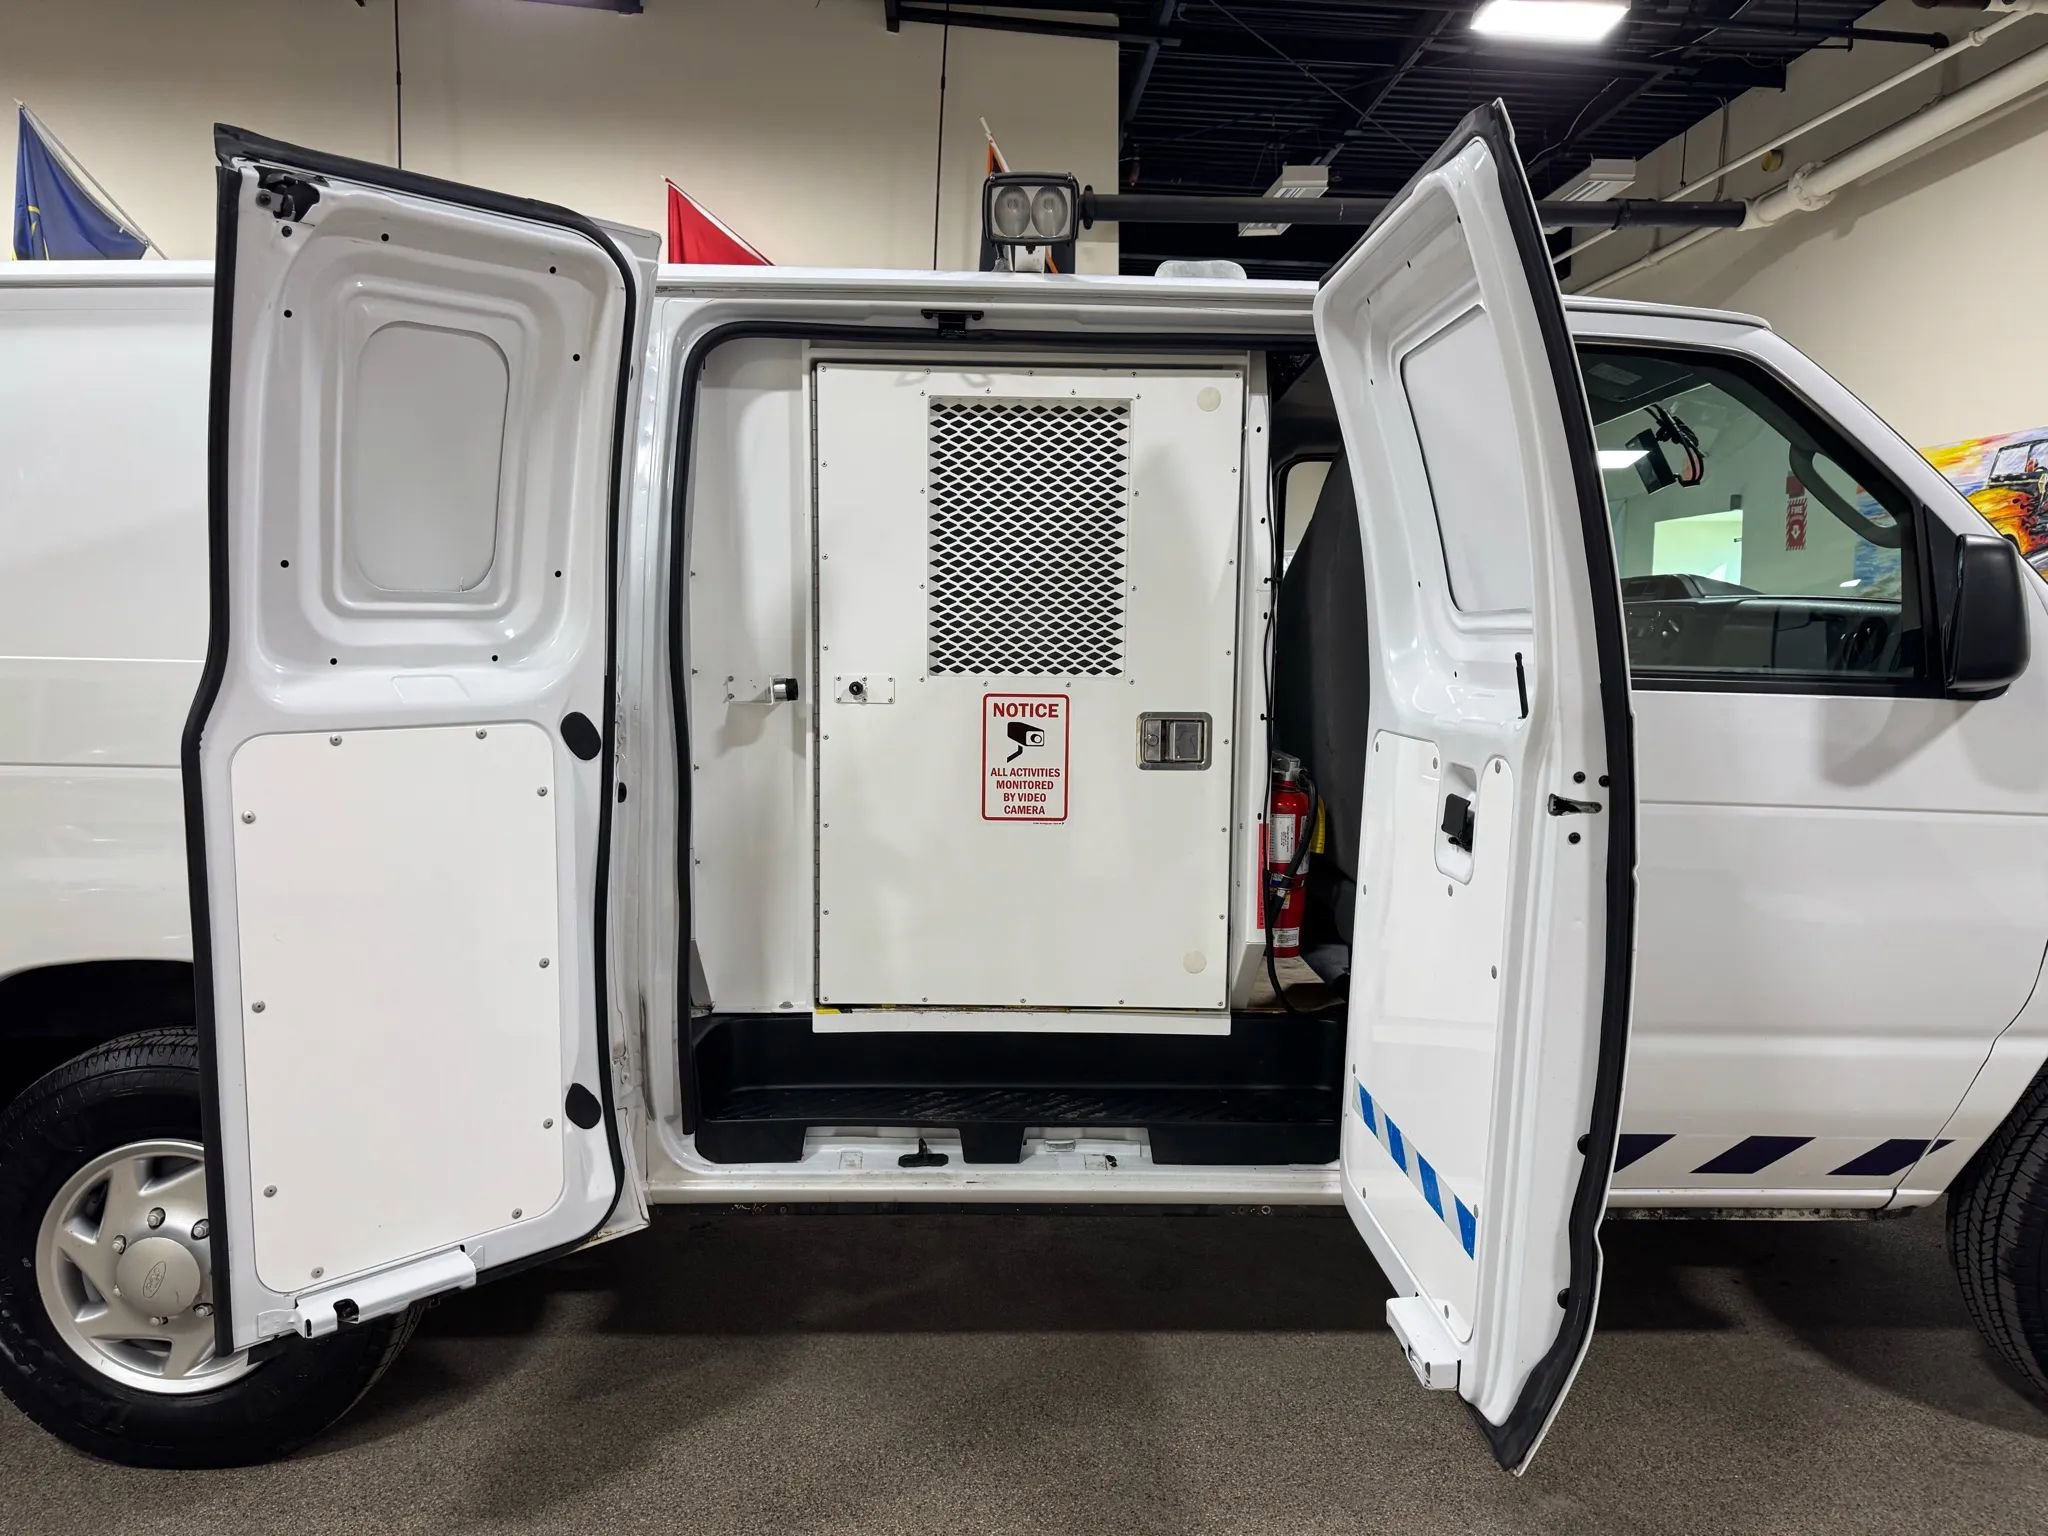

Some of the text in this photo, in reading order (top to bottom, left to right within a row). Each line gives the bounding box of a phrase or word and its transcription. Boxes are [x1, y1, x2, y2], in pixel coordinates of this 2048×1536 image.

[993, 702, 1059, 718] NOTICE
[990, 768, 1060, 777] ALL ACTIVITIES
[996, 780, 1054, 790] MONITORED
[1003, 792, 1047, 802] BY VIDEO
[1004, 805, 1045, 815] CAMERA
